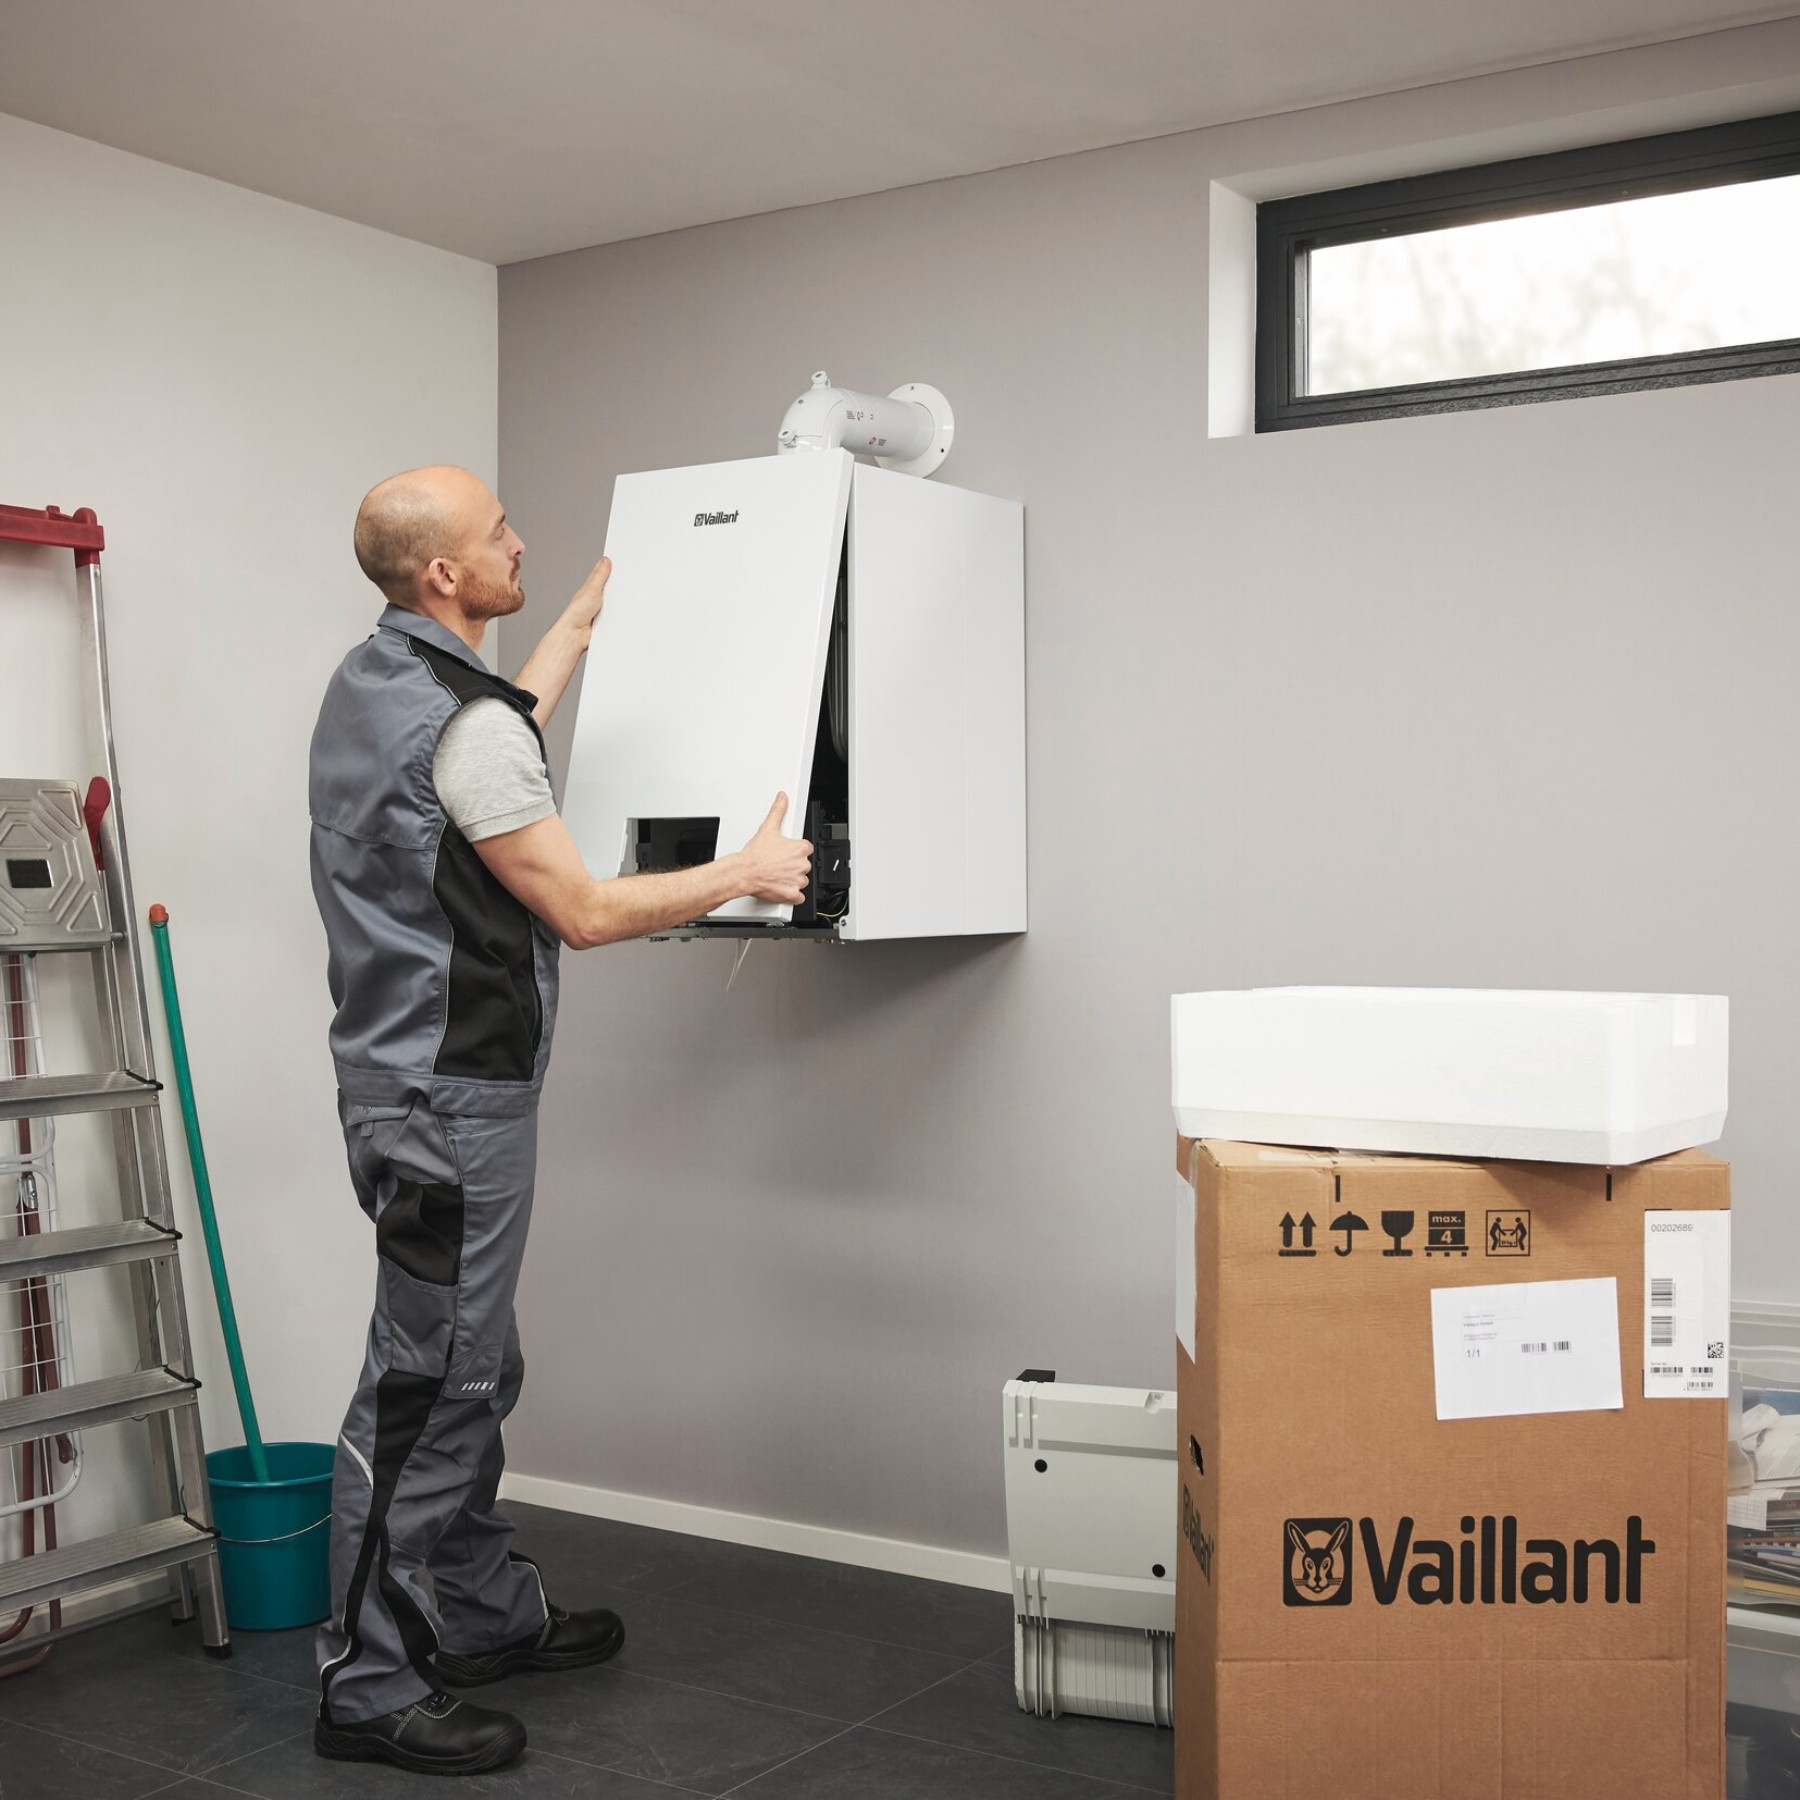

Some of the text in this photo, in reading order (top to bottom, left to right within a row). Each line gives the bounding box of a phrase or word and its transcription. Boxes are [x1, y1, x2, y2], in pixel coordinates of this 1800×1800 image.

[704, 510, 739, 525] Vaillant
[1432, 1215, 1462, 1223] max.
[1441, 1230, 1453, 1244] 4
[1359, 1515, 1655, 1605] Vaillant
